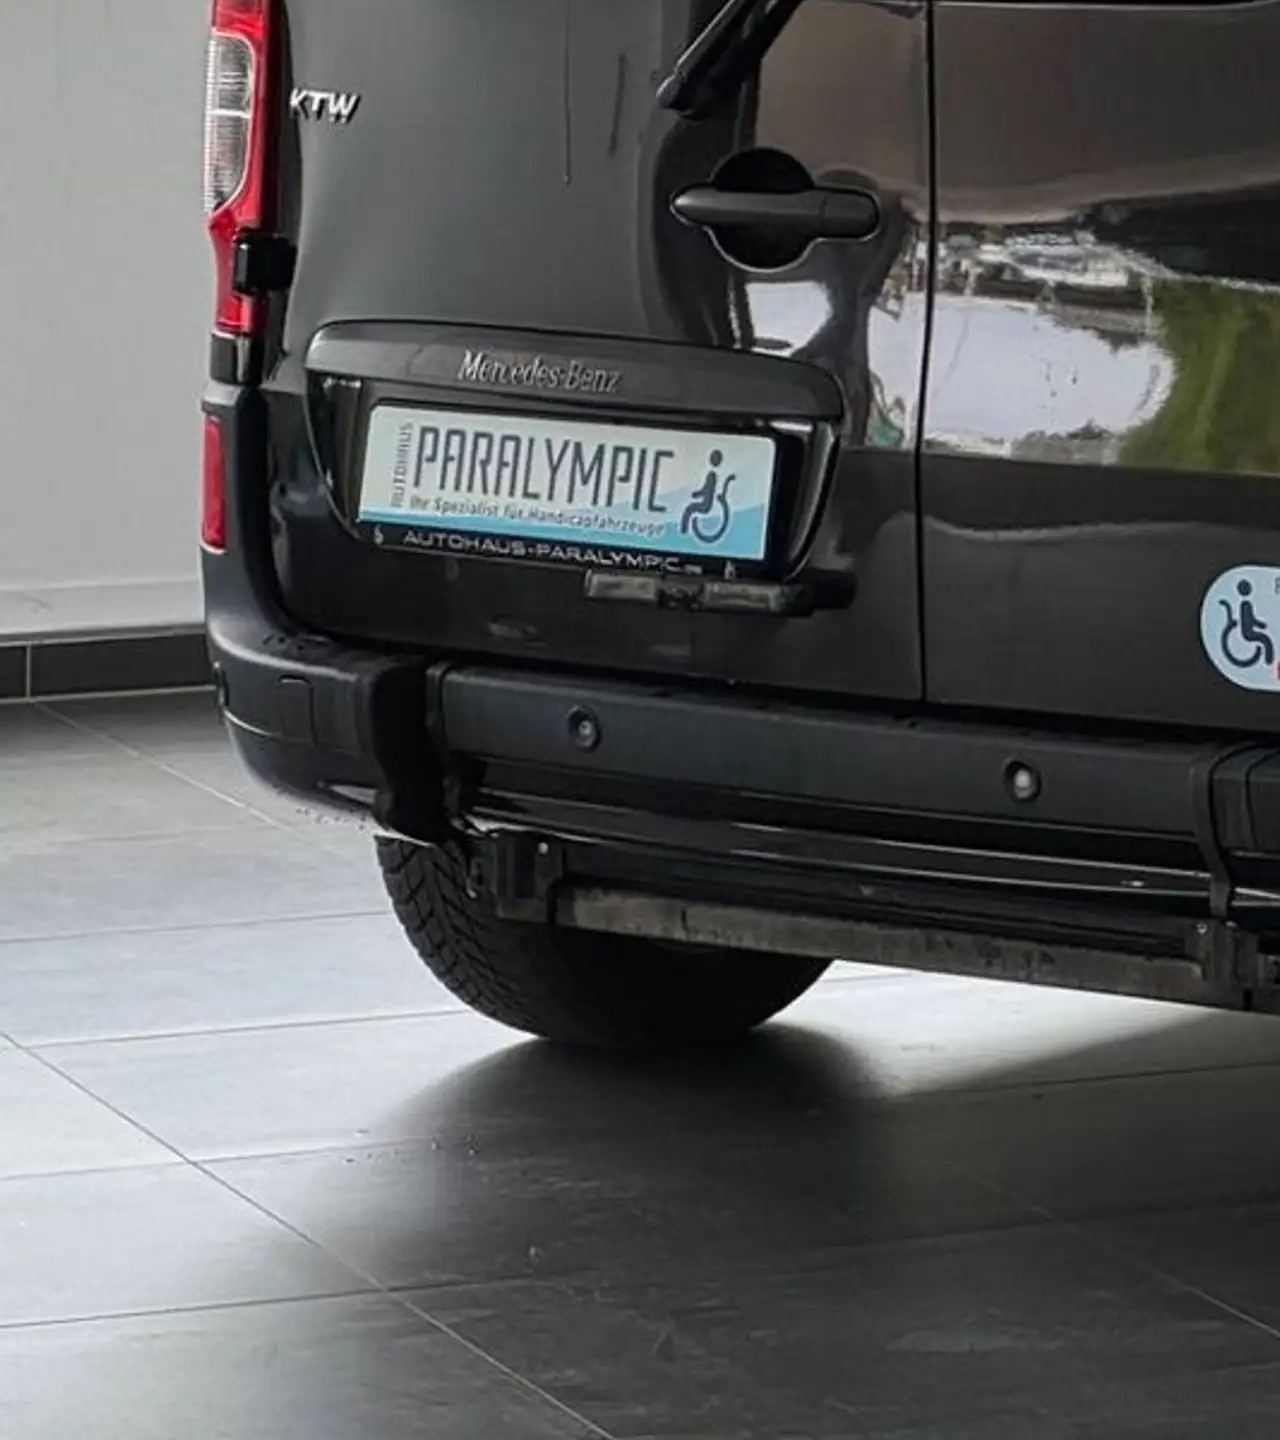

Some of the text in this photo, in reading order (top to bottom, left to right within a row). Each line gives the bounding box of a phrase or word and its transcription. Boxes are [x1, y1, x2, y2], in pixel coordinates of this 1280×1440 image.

[289, 87, 362, 123] KTW
[457, 349, 622, 393] Mercedes-Benz
[413, 424, 675, 514] PARALYMPIC
[433, 495, 499, 518] Spezialist
[502, 502, 524, 519] für
